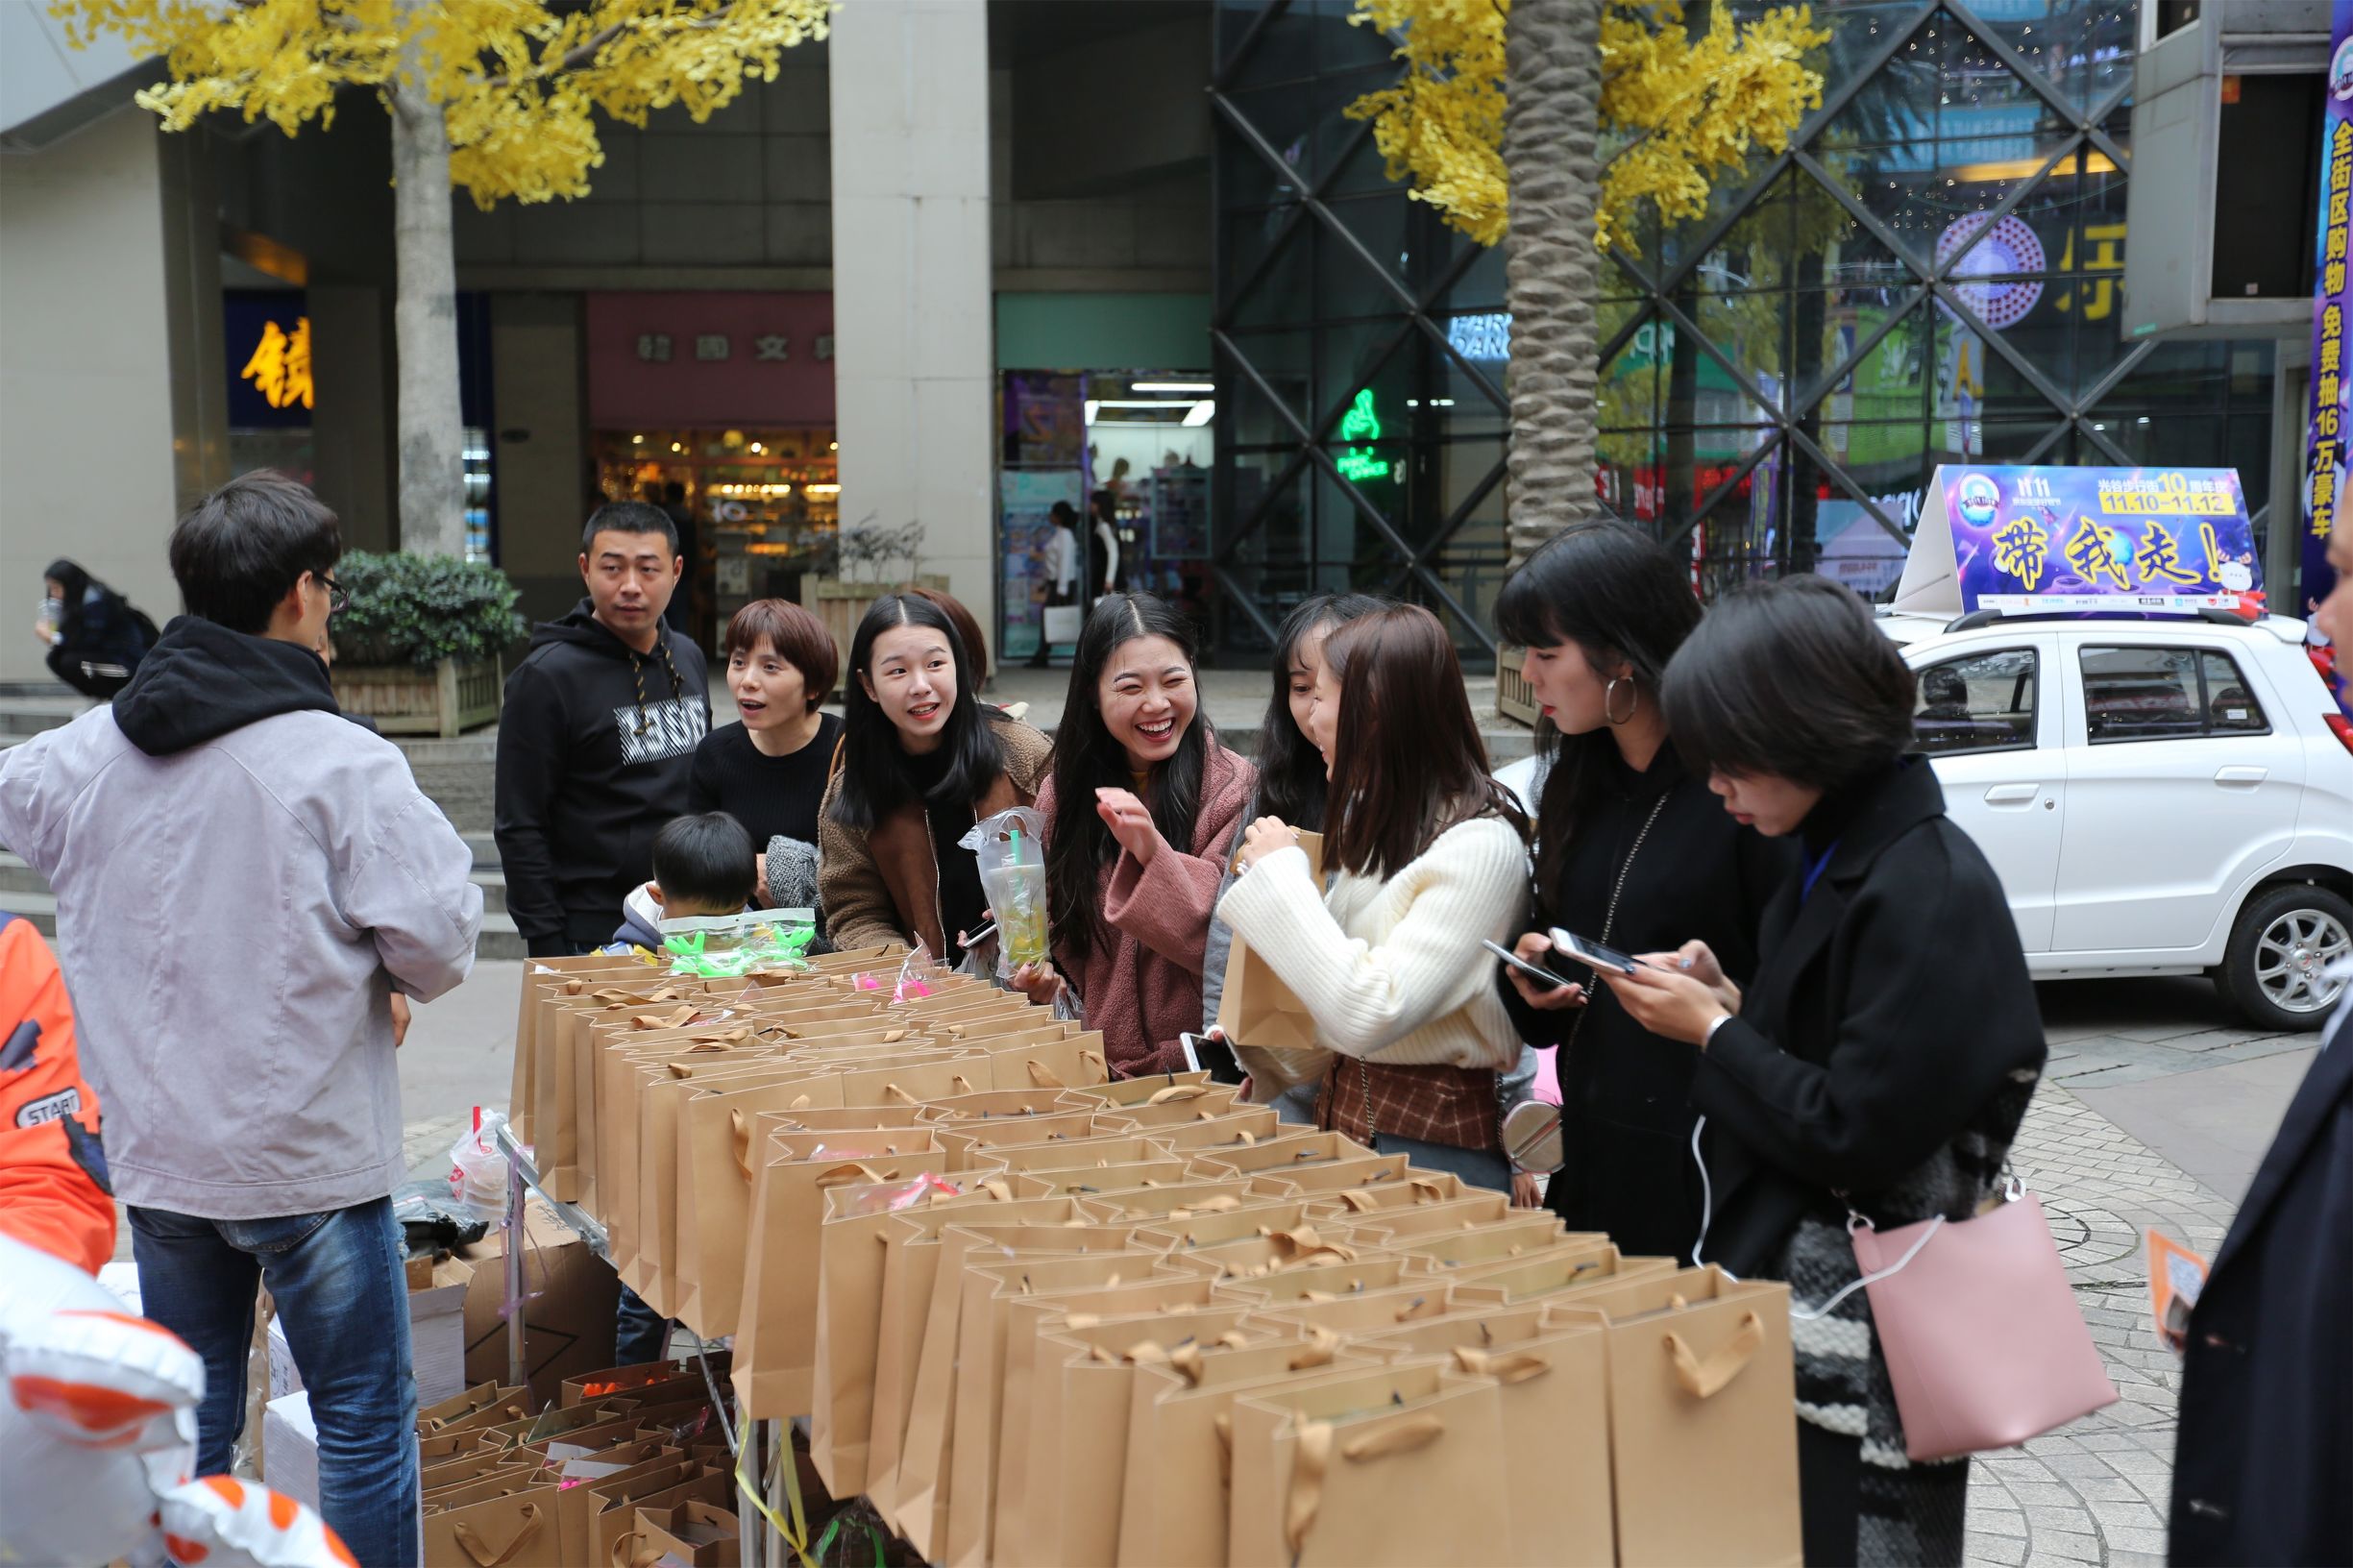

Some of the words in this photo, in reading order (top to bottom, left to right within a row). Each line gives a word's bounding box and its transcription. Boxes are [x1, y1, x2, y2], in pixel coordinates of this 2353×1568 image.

[2323, 120, 2353, 297] 全街区购物
[2311, 305, 2342, 539] 免费抽16万豪车
[28, 1095, 77, 1126] START
